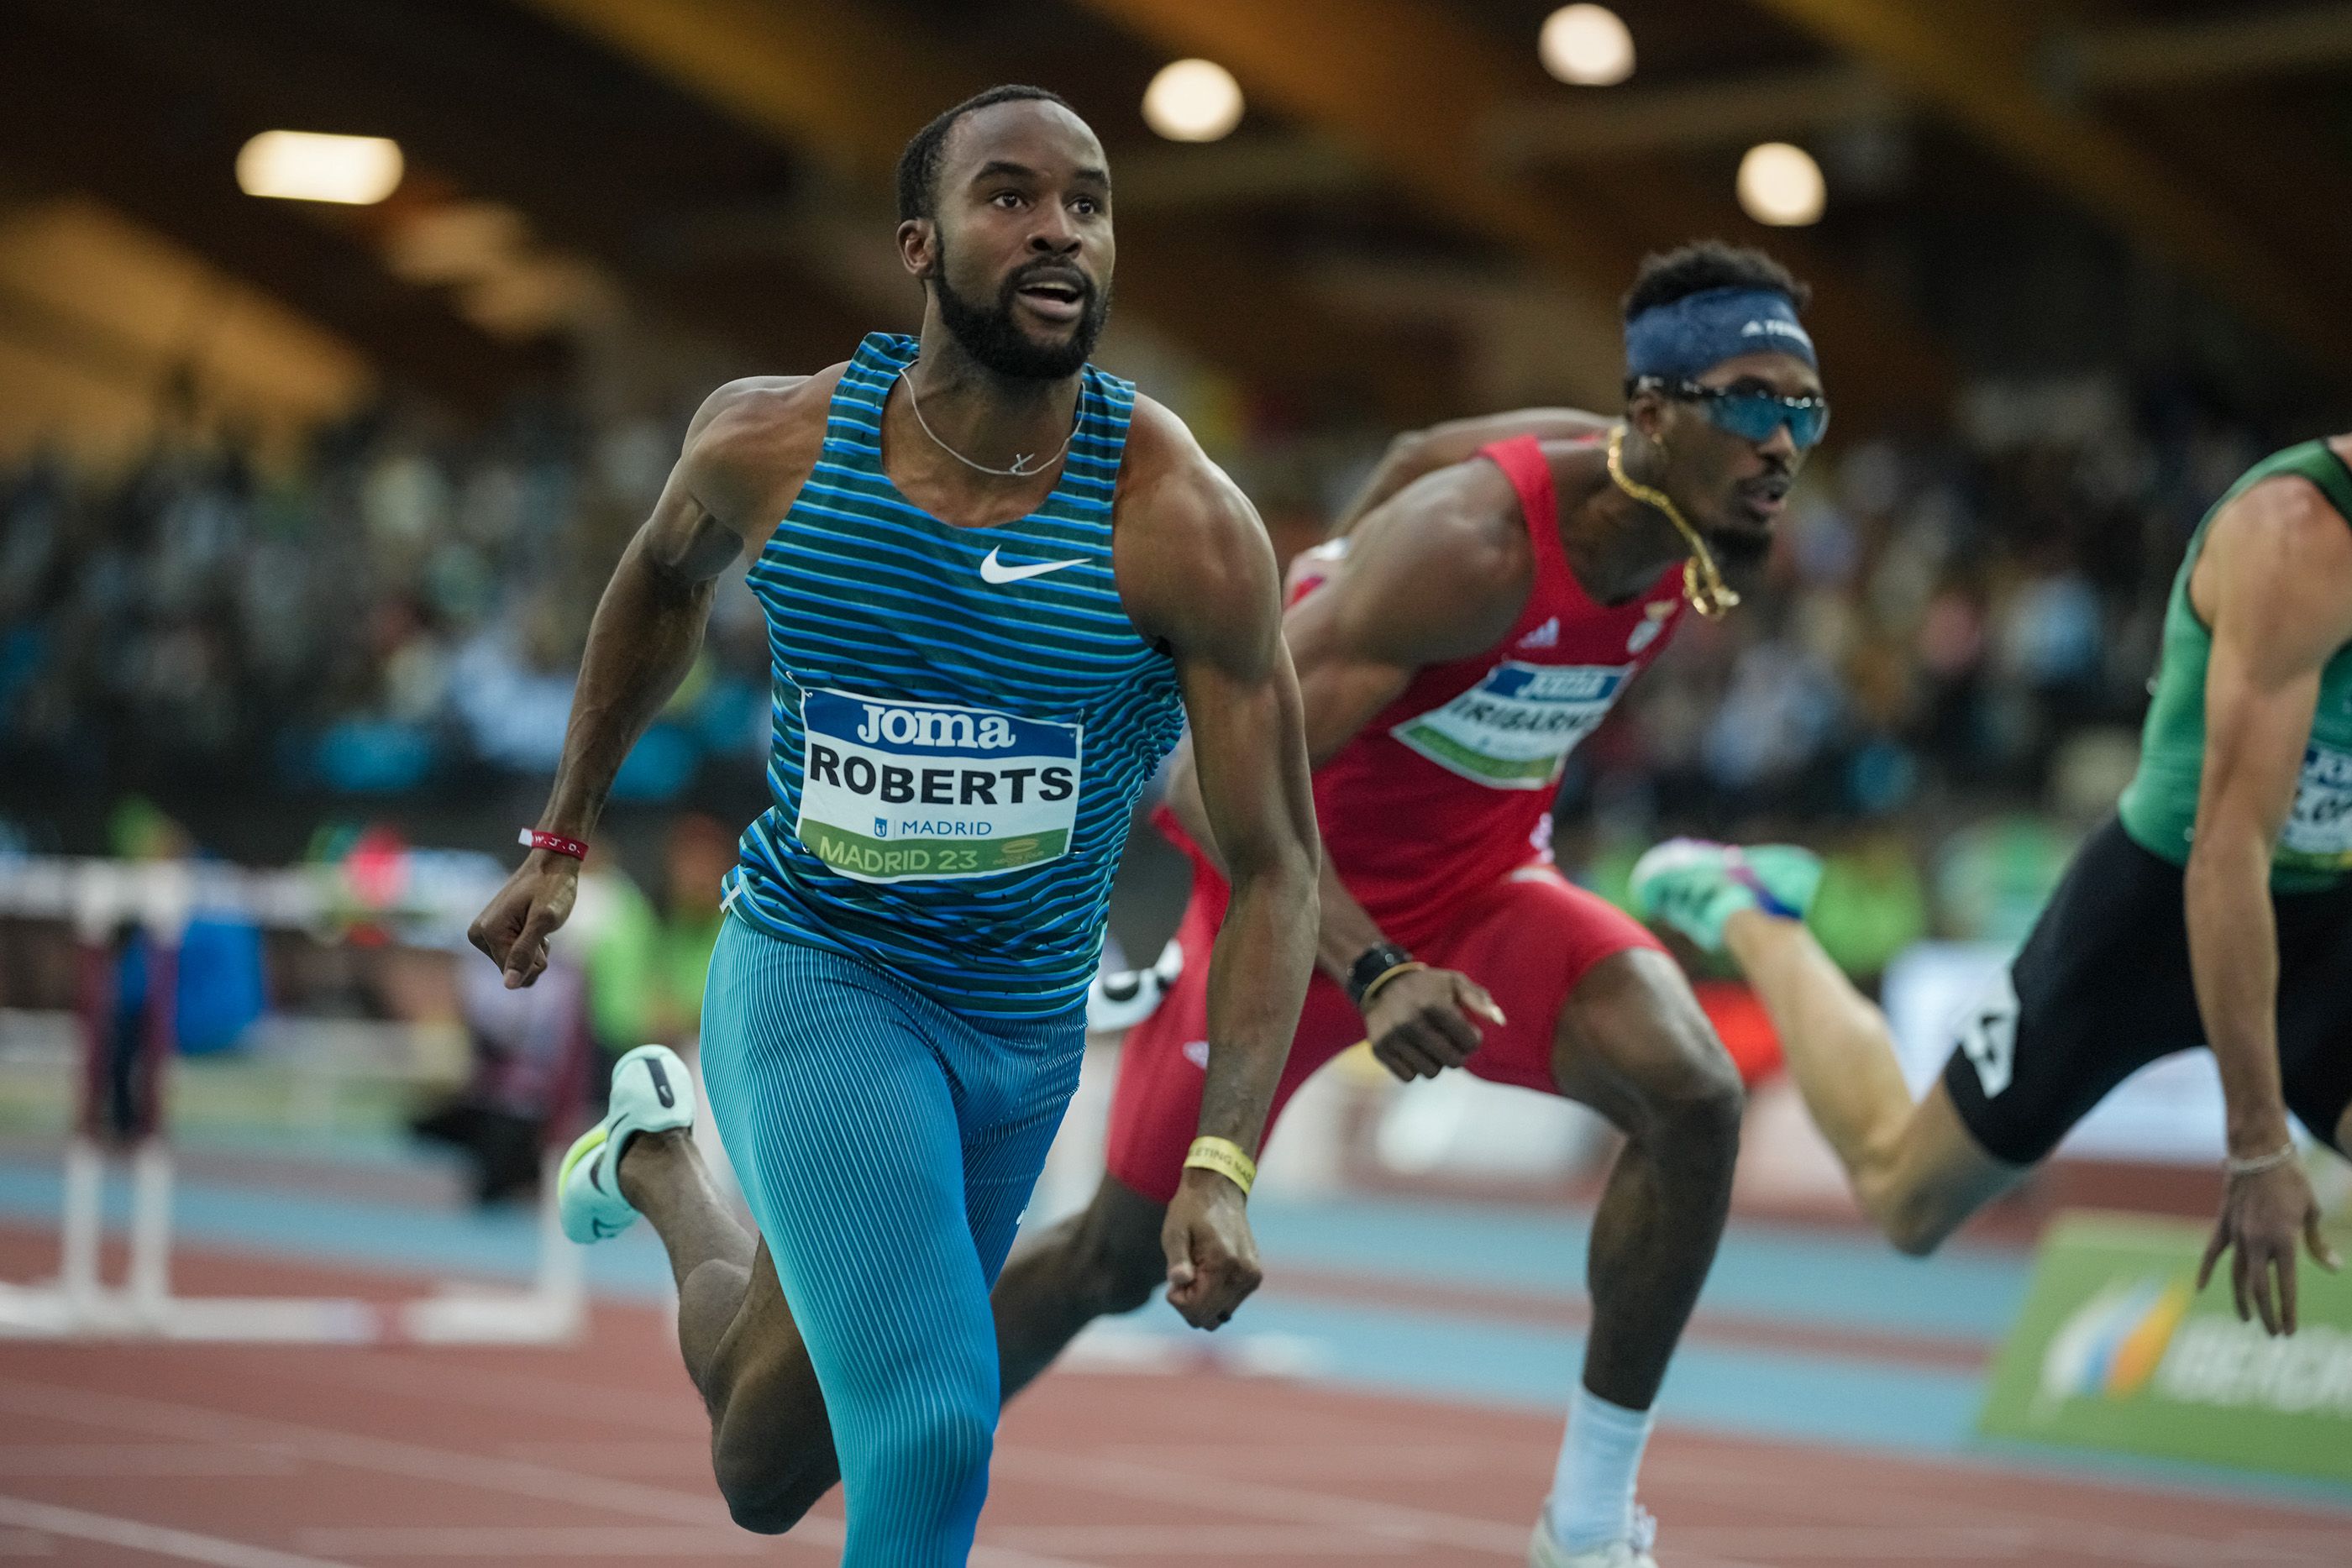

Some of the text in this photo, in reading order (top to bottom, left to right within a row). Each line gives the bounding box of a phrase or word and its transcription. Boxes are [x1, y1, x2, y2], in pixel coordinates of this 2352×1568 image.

[810, 742, 1073, 805] ROBERTS
[902, 820, 991, 836] MADRID
[819, 836, 931, 873] MADRID
[937, 849, 978, 870] 23
